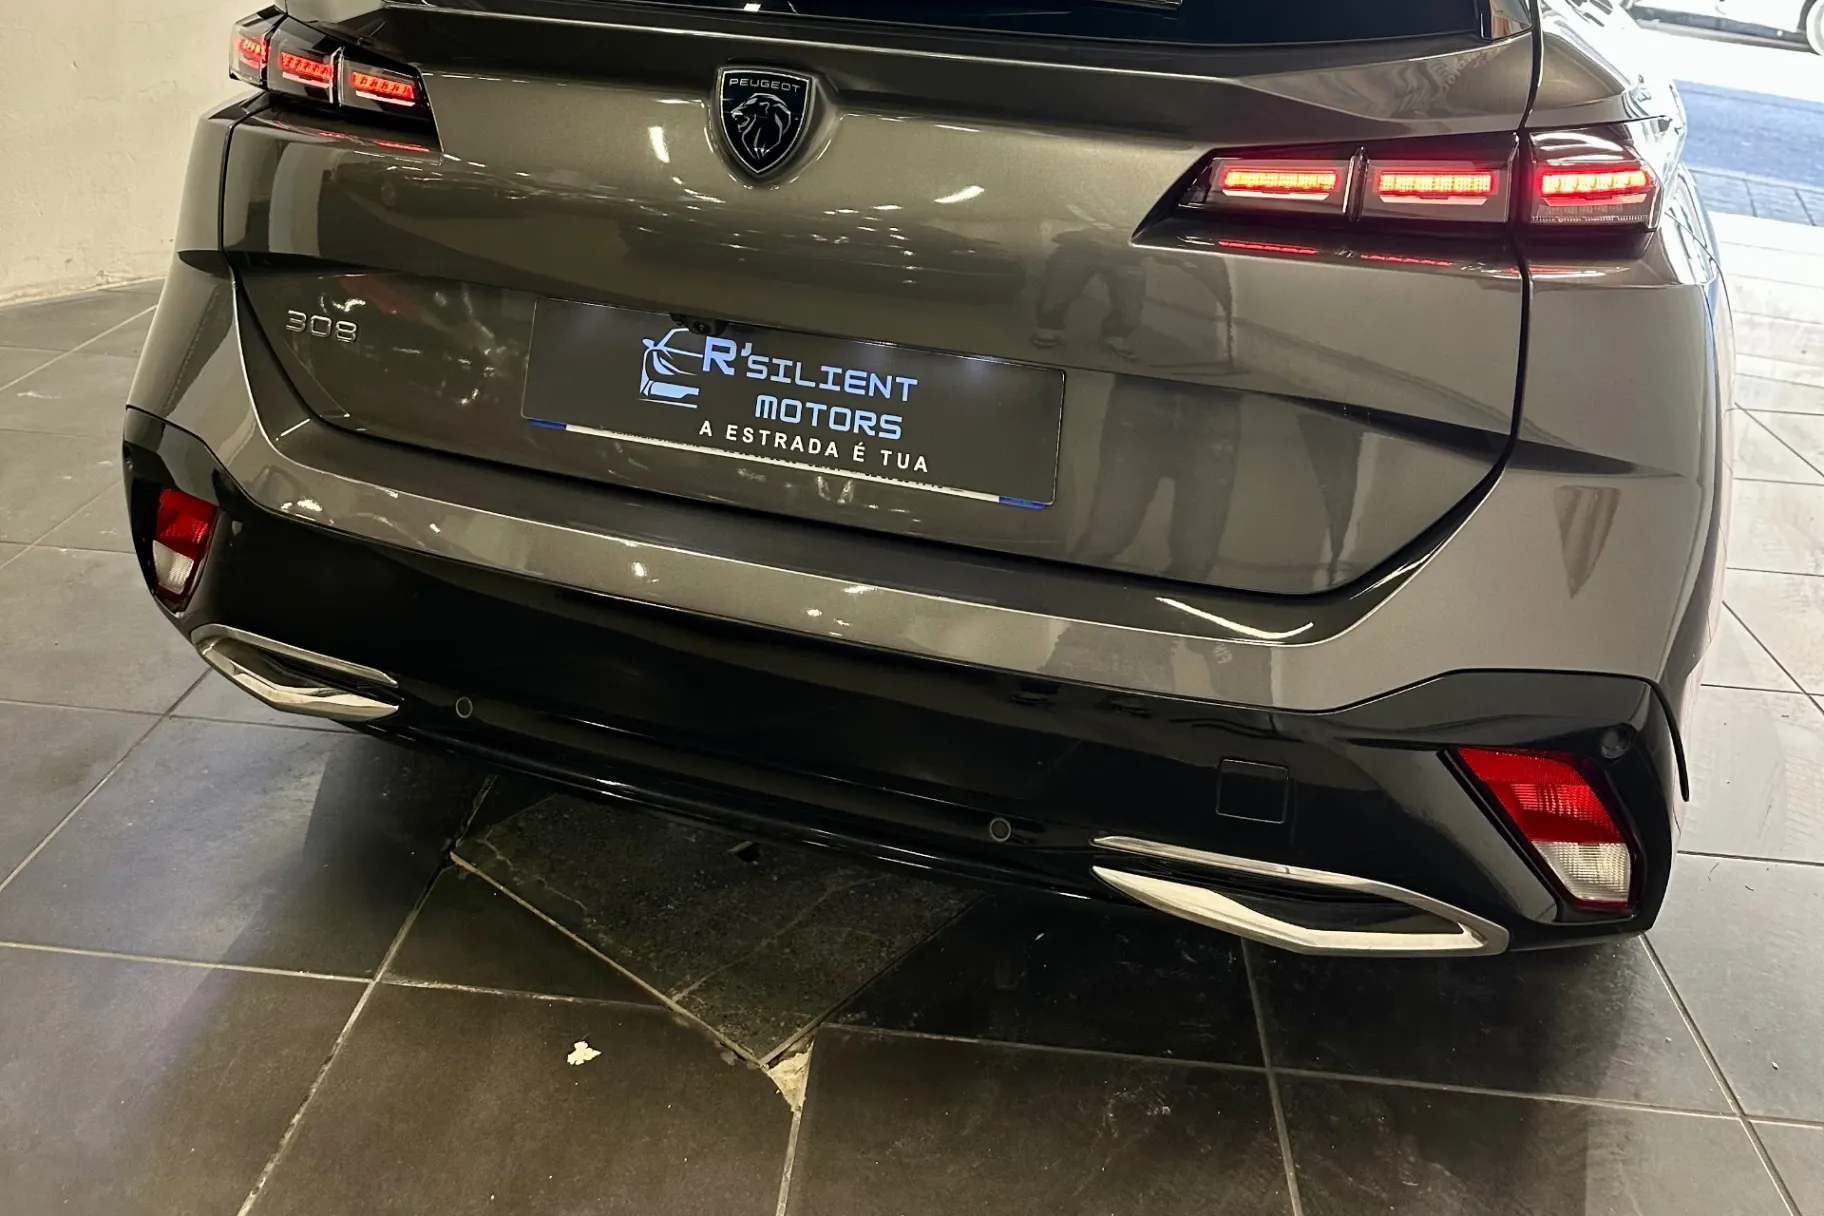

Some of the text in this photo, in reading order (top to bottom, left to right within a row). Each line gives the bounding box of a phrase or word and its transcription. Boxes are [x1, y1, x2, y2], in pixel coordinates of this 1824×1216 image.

[729, 78, 801, 93] PEUGEOT
[285, 309, 358, 343] 308
[702, 335, 918, 402] R'SILIENT
[755, 394, 903, 440] MOTORS
[699, 420, 713, 437] A
[725, 424, 839, 458] ESTRADA
[852, 442, 865, 463] É
[880, 450, 929, 473] TUA
